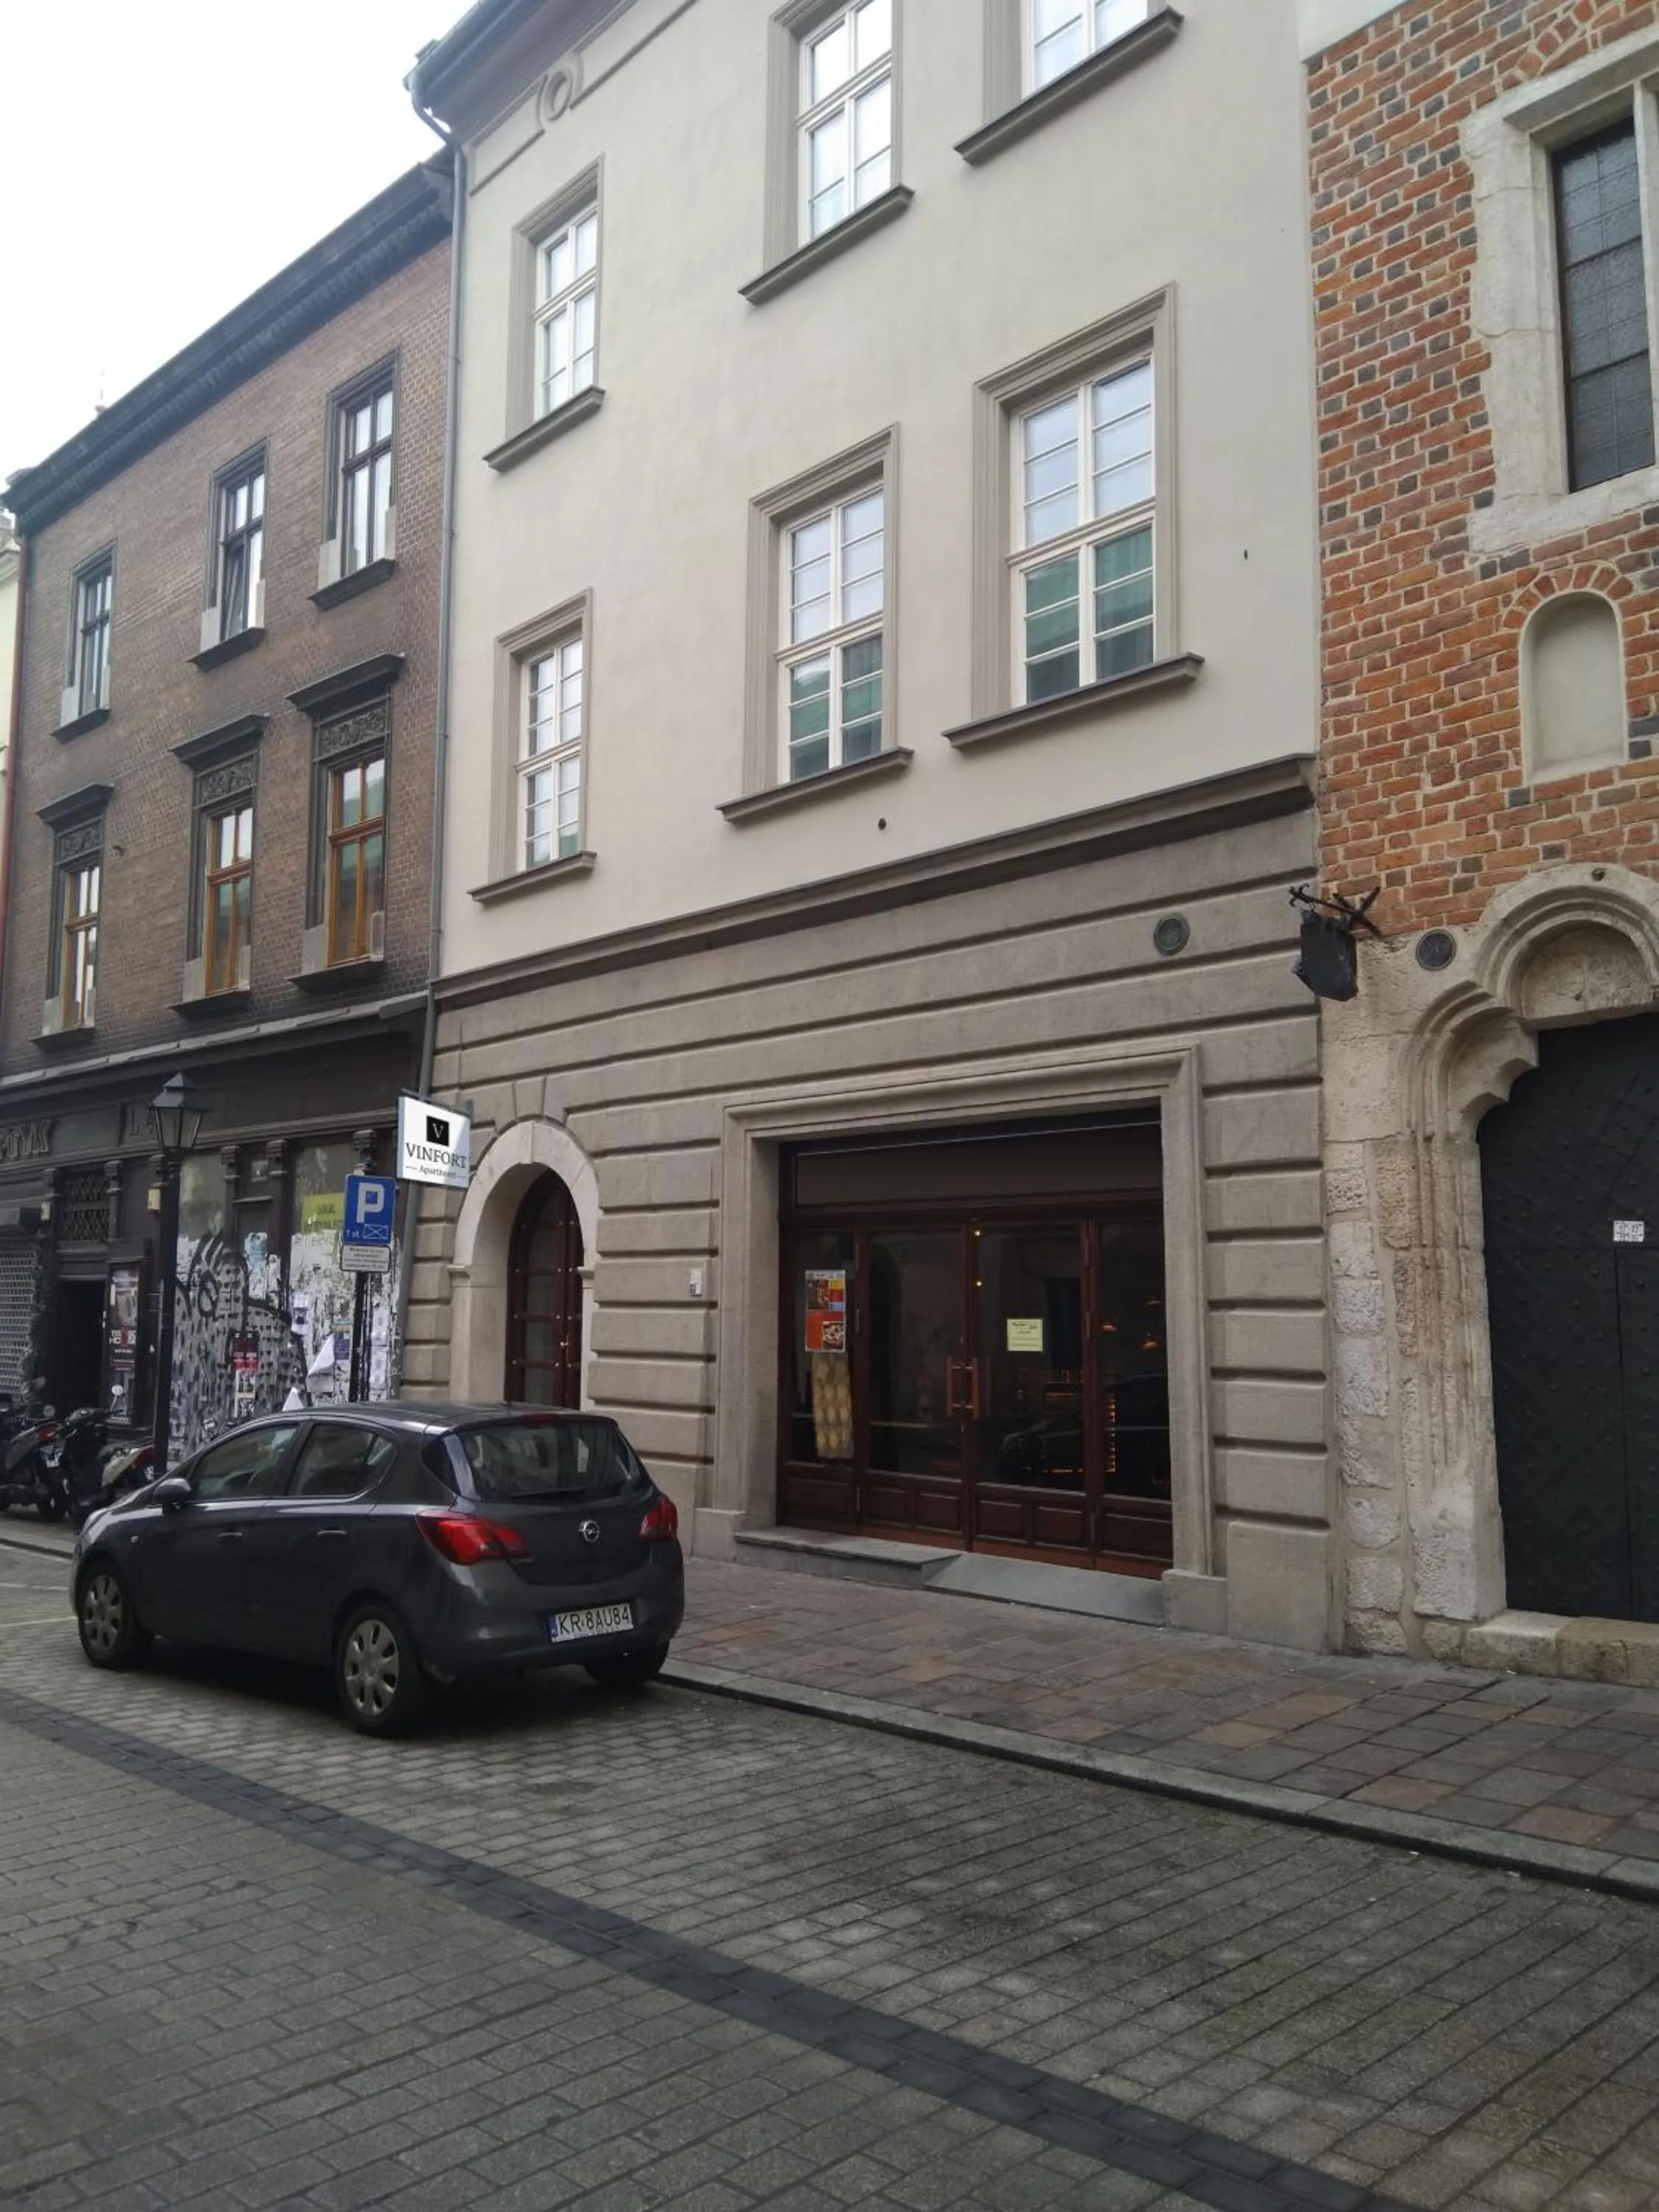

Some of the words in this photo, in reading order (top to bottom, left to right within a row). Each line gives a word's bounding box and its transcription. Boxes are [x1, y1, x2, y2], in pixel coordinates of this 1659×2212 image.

[432, 1122, 444, 1139] V
[405, 1142, 467, 1169] VINFORT
[356, 1182, 385, 1224] P
[558, 1613, 582, 1635] KR
[585, 1607, 630, 1630] 8AU84
